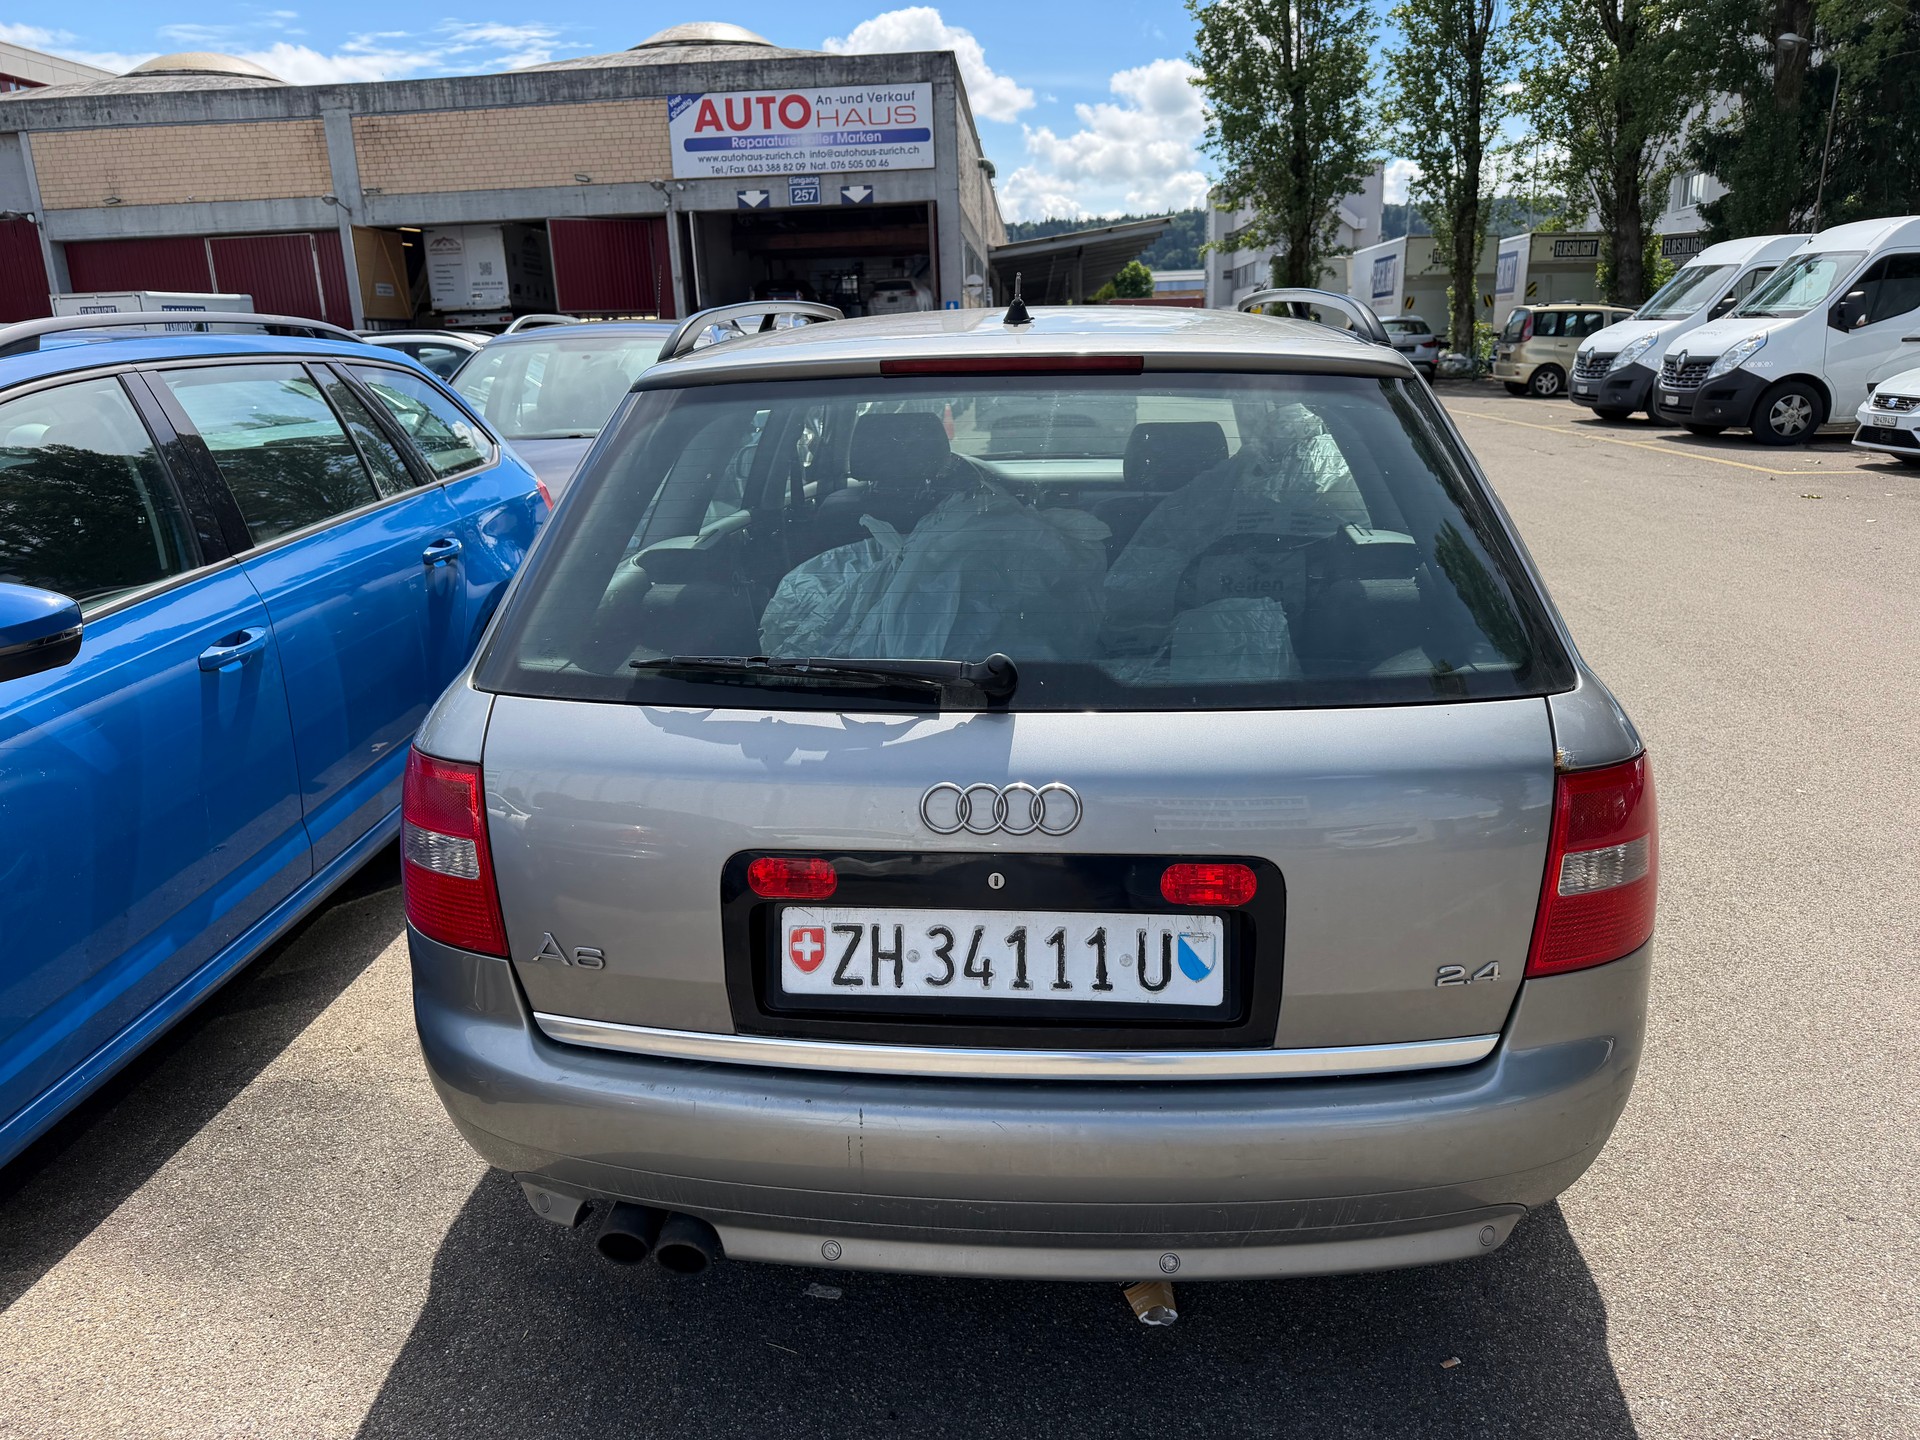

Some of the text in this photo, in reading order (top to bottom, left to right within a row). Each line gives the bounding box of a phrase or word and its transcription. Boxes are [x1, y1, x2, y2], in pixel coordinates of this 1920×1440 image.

[816, 95, 832, 105] An
[866, 90, 916, 103] Verkauf
[694, 94, 812, 133] AUTO
[816, 105, 917, 128] HAUS
[836, 131, 882, 144] Marken
[747, 164, 763, 173] 043
[795, 162, 806, 172] 09
[830, 161, 846, 170] 076
[865, 159, 877, 168] 00
[788, 176, 820, 185] Eingang
[793, 189, 816, 201] 257
[1555, 241, 1597, 256] FLASHLIGHT
[532, 931, 606, 970] A6
[831, 923, 1174, 995] ZH 34111 U
[1435, 961, 1501, 987] 2.4
